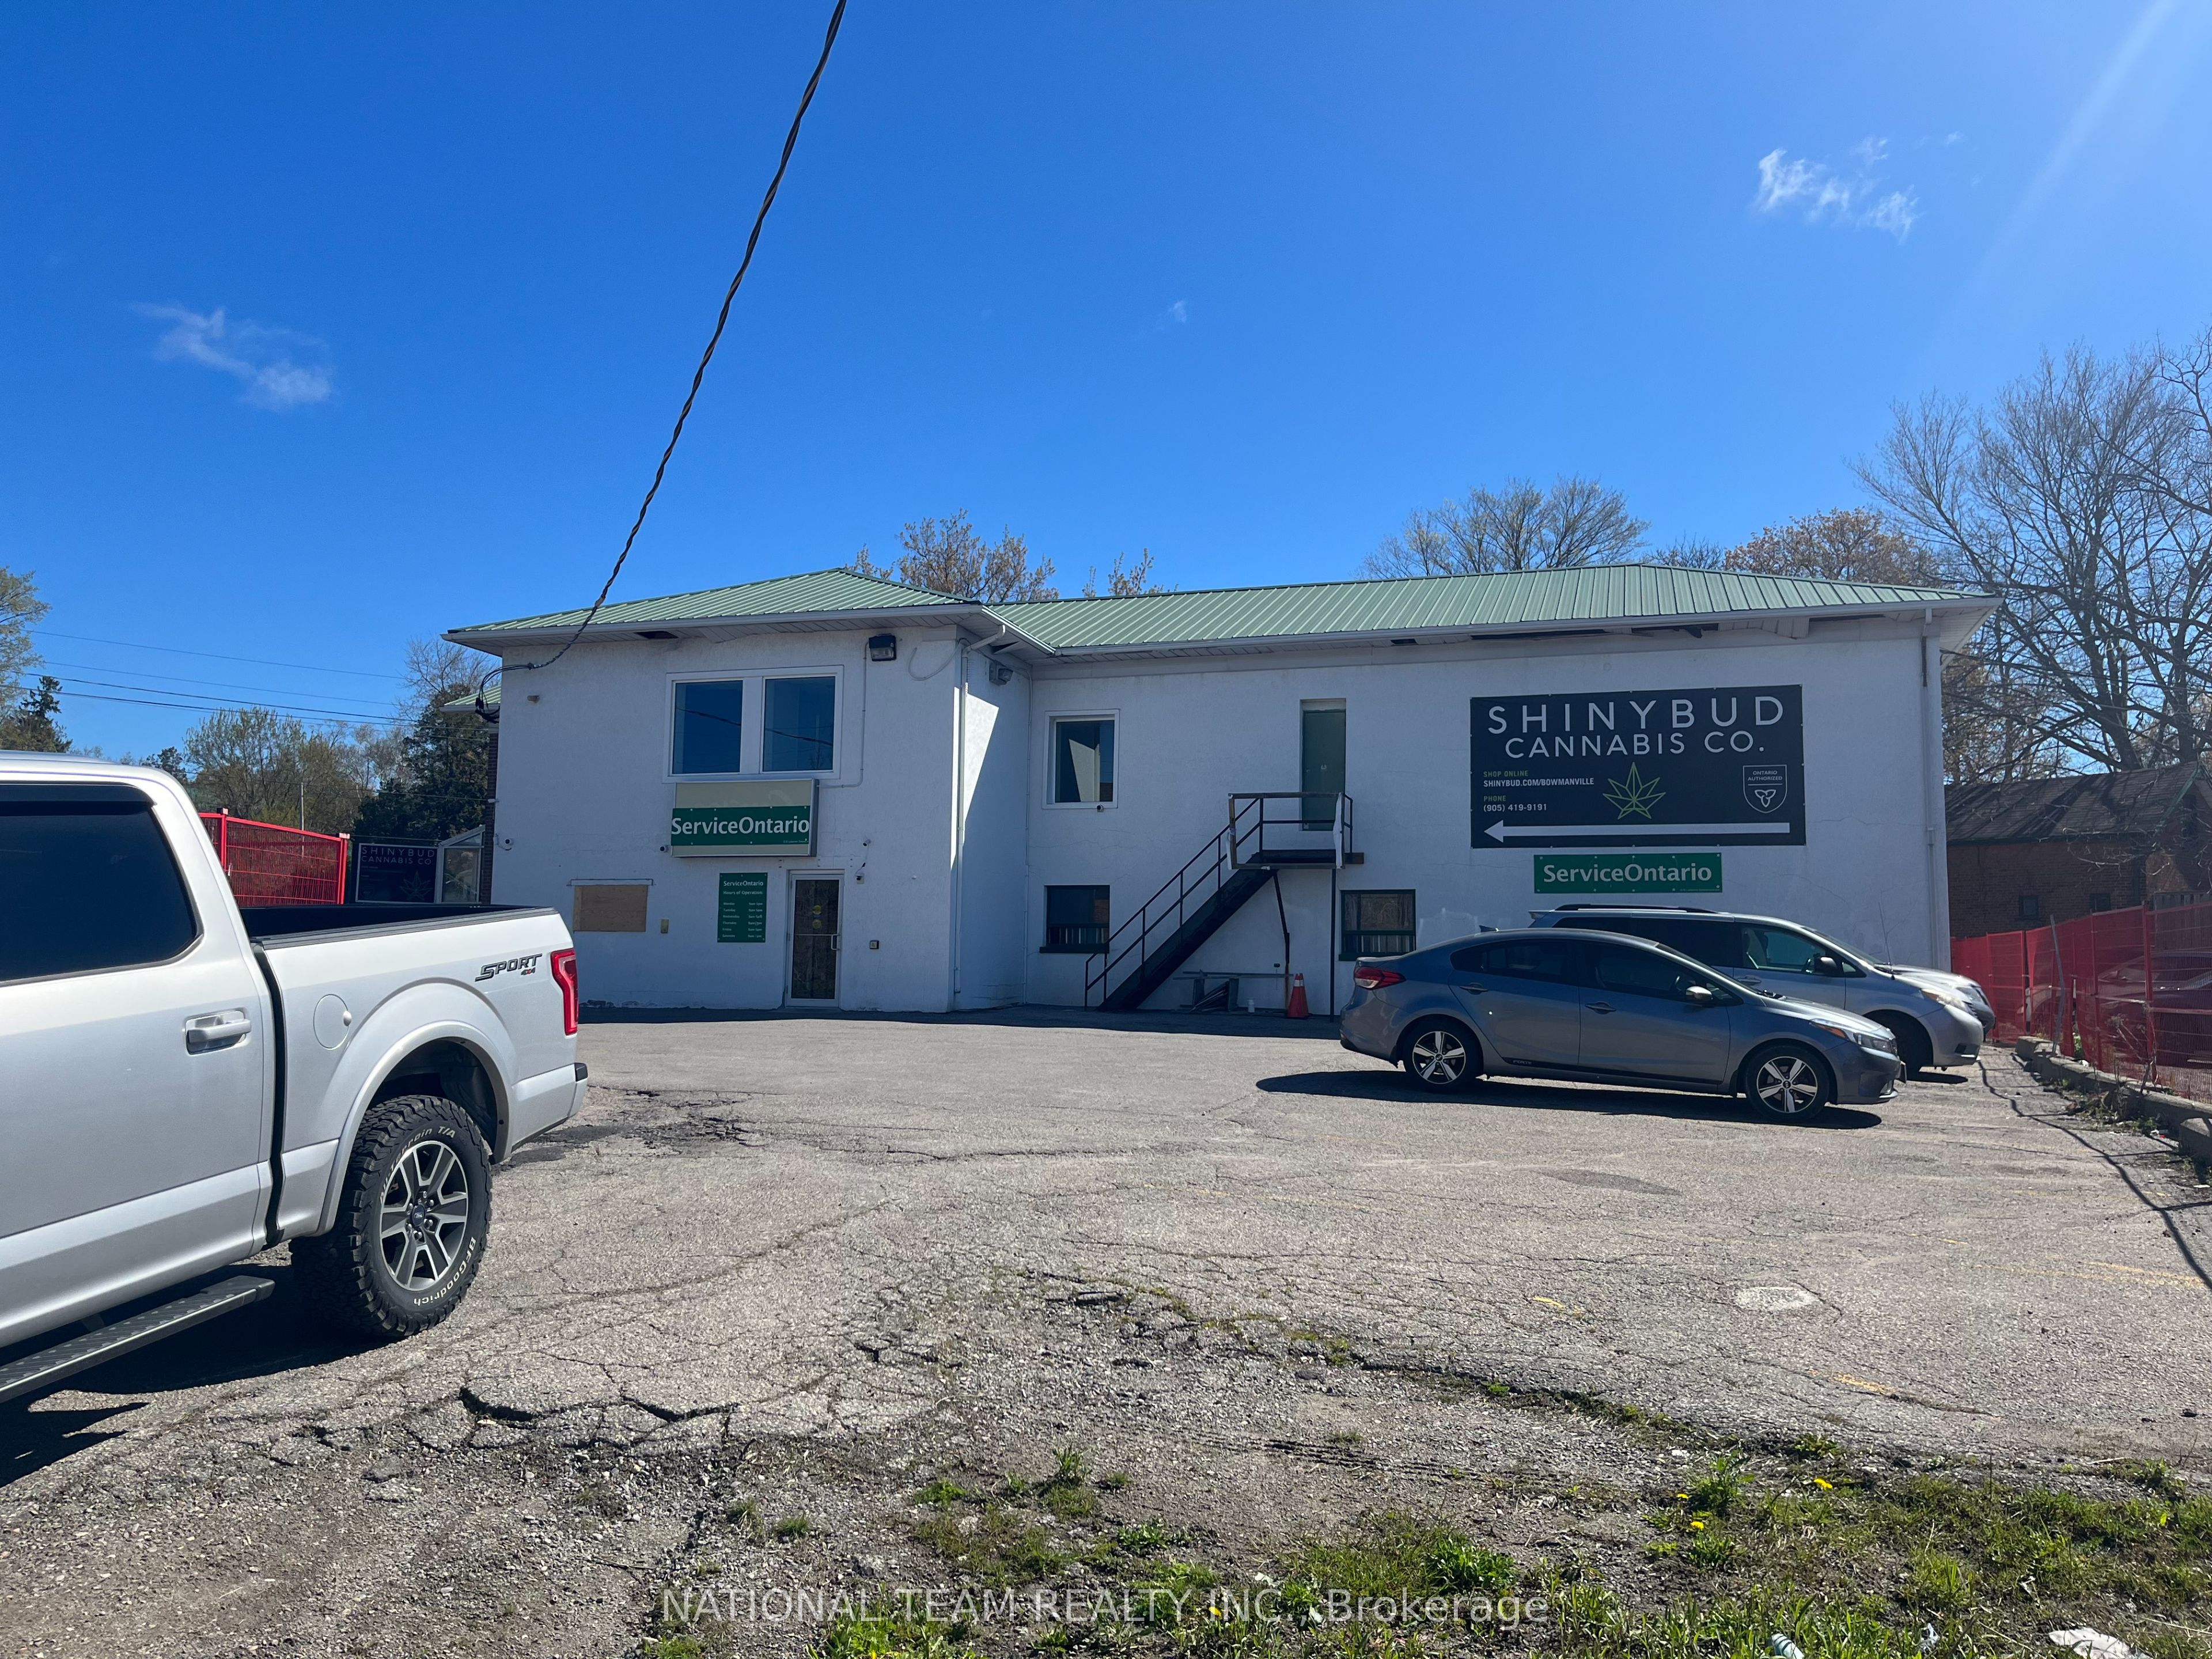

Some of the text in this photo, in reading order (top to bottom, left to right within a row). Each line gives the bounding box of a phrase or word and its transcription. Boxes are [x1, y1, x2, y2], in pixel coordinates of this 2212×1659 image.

[1488, 696, 1783, 734] SHINYBUD
[1505, 730, 1765, 759] CANNABIS CO.
[1483, 778, 1594, 787] SHINYBUD.COM/BOWMANVILLE
[1483, 804, 1547, 812] (905) 419-9191
[671, 816, 810, 835] ServiceOntario
[361, 847, 435, 858] SHINYBUD
[361, 855, 414, 864] CANNABIS
[1543, 863, 1712, 882] ServiceOntario
[475, 953, 543, 982] SPORT
[414, 1236, 476, 1306] BFGoodrich
